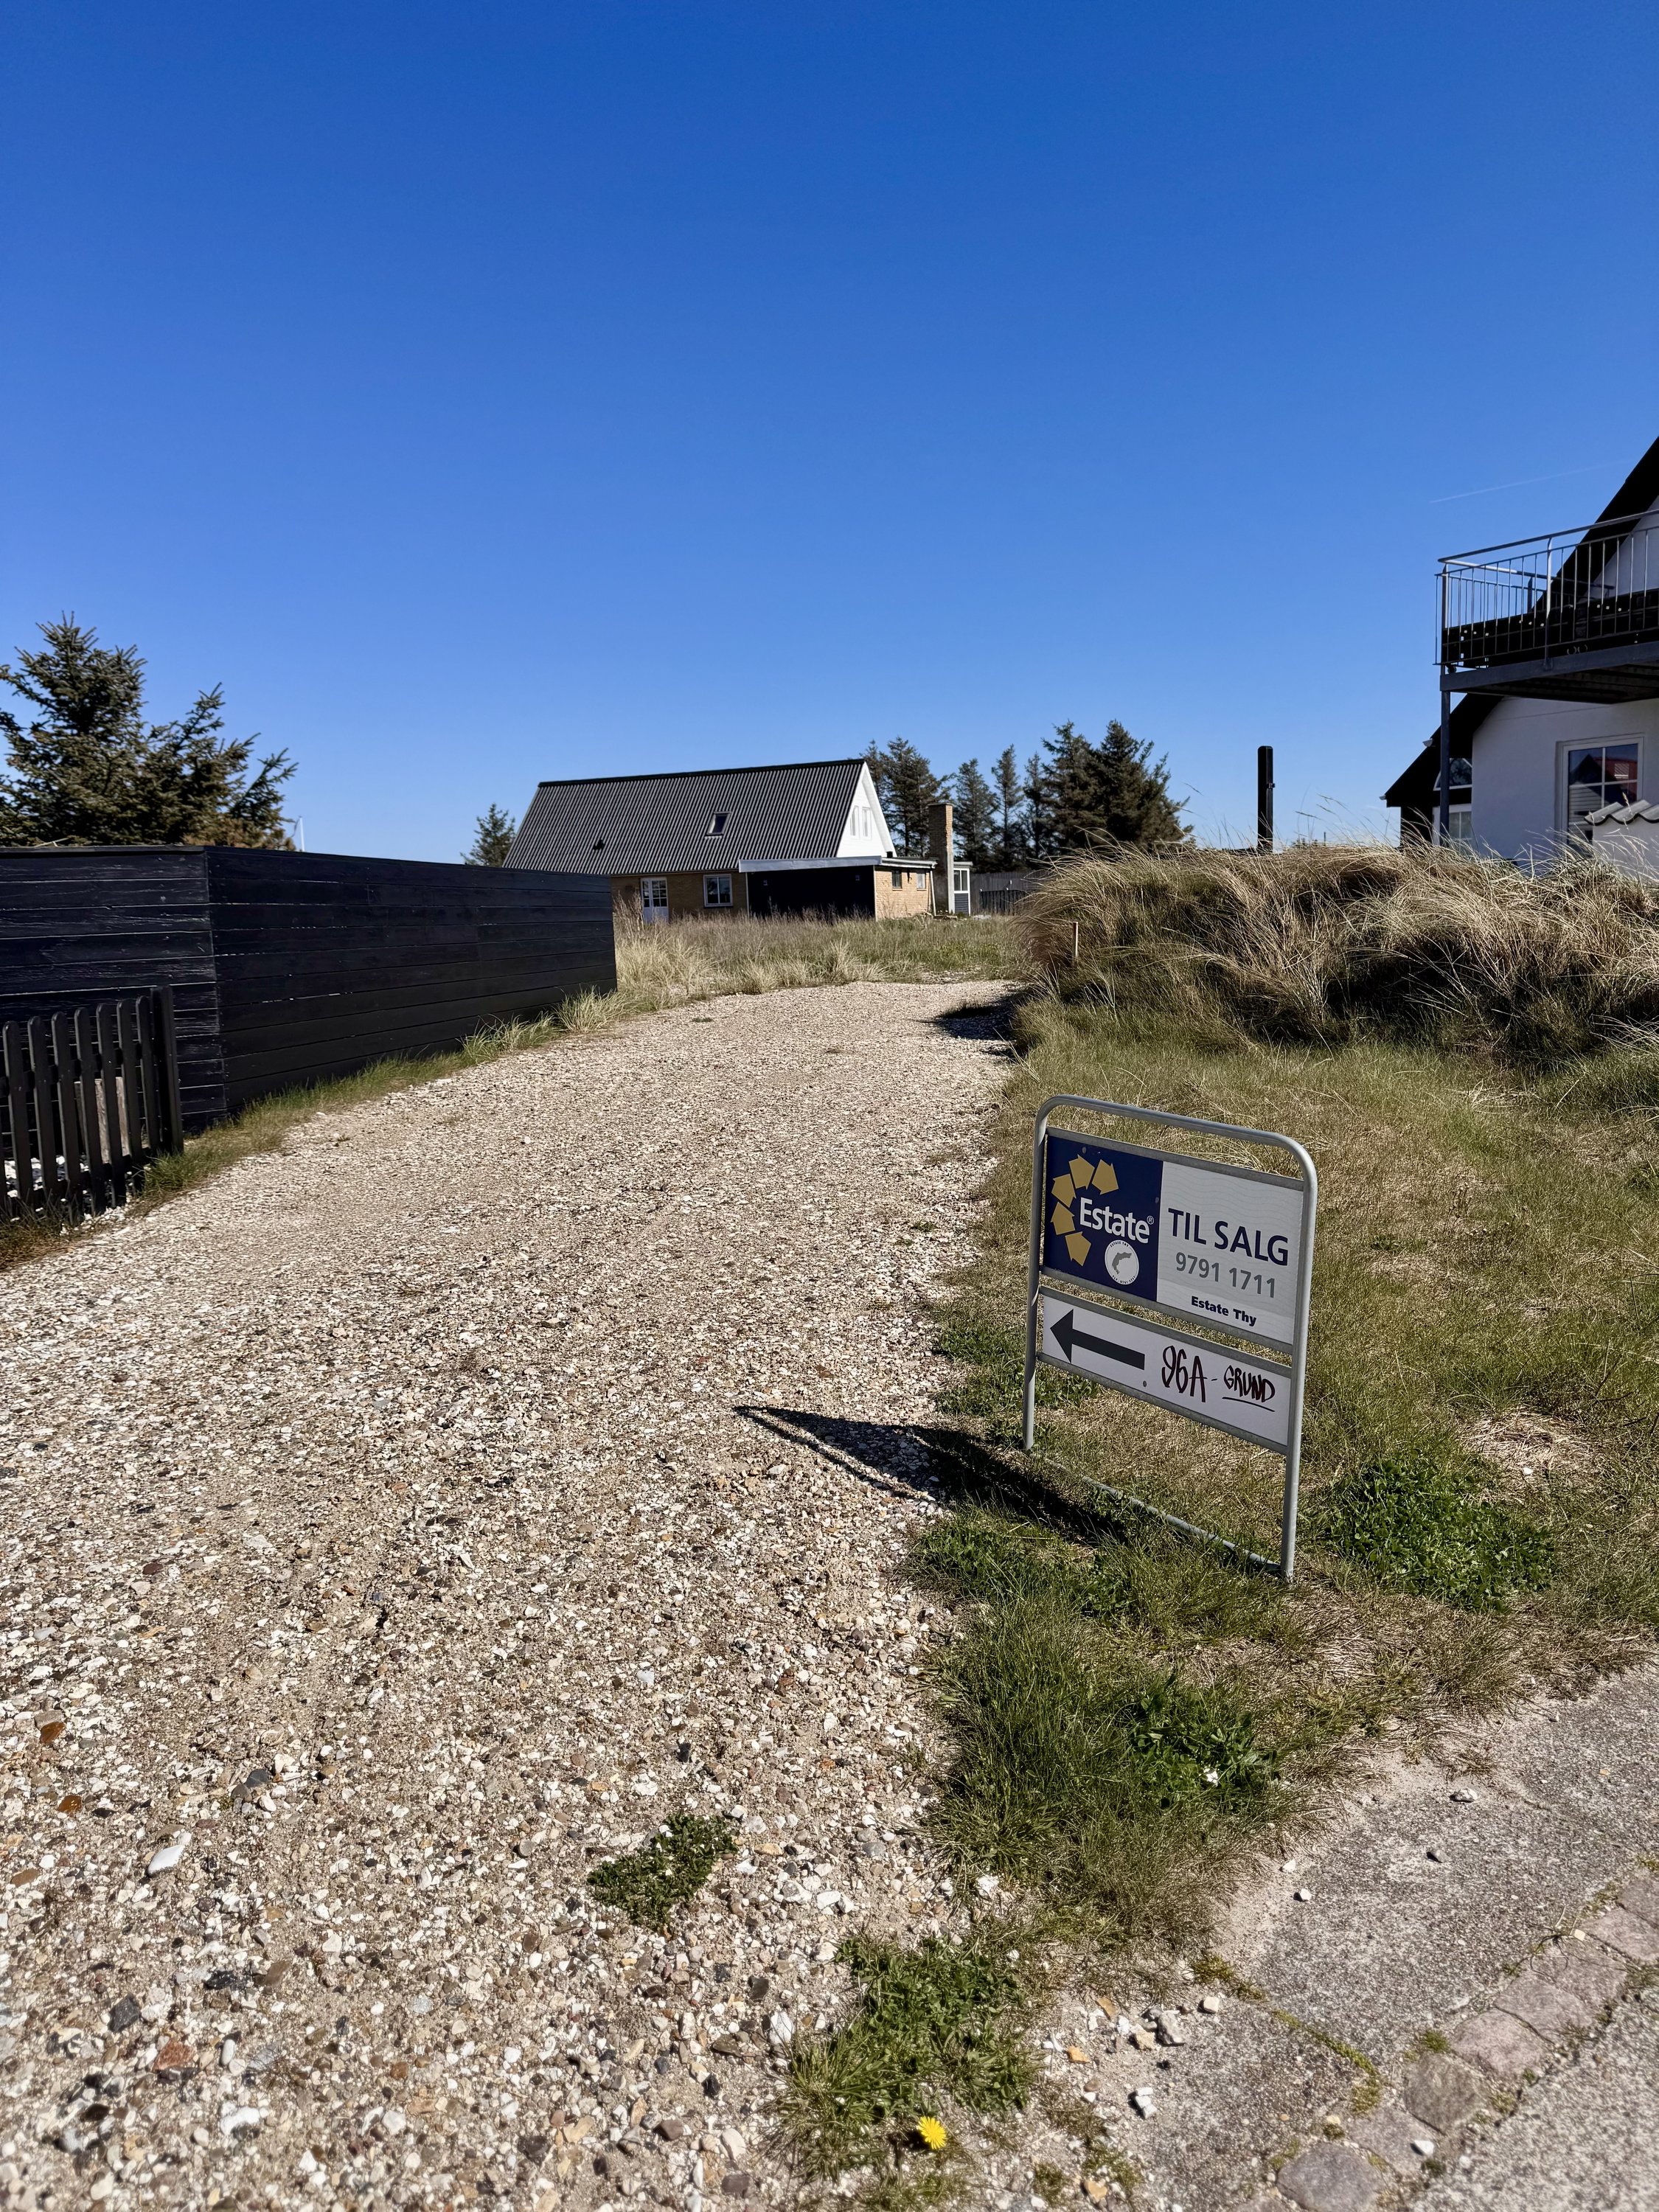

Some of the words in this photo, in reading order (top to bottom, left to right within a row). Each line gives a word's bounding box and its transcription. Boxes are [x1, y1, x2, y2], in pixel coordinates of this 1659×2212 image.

[1168, 1208, 1207, 1245] TIL
[1214, 1220, 1289, 1266] SALG
[1175, 1252, 1220, 1282] 9791
[1228, 1267, 1275, 1298] 1711
[1191, 1295, 1229, 1316] Estate
[1233, 1308, 1257, 1326] Thy
[1161, 1345, 1208, 1402] 96A
[1223, 1365, 1276, 1402] GRUND
